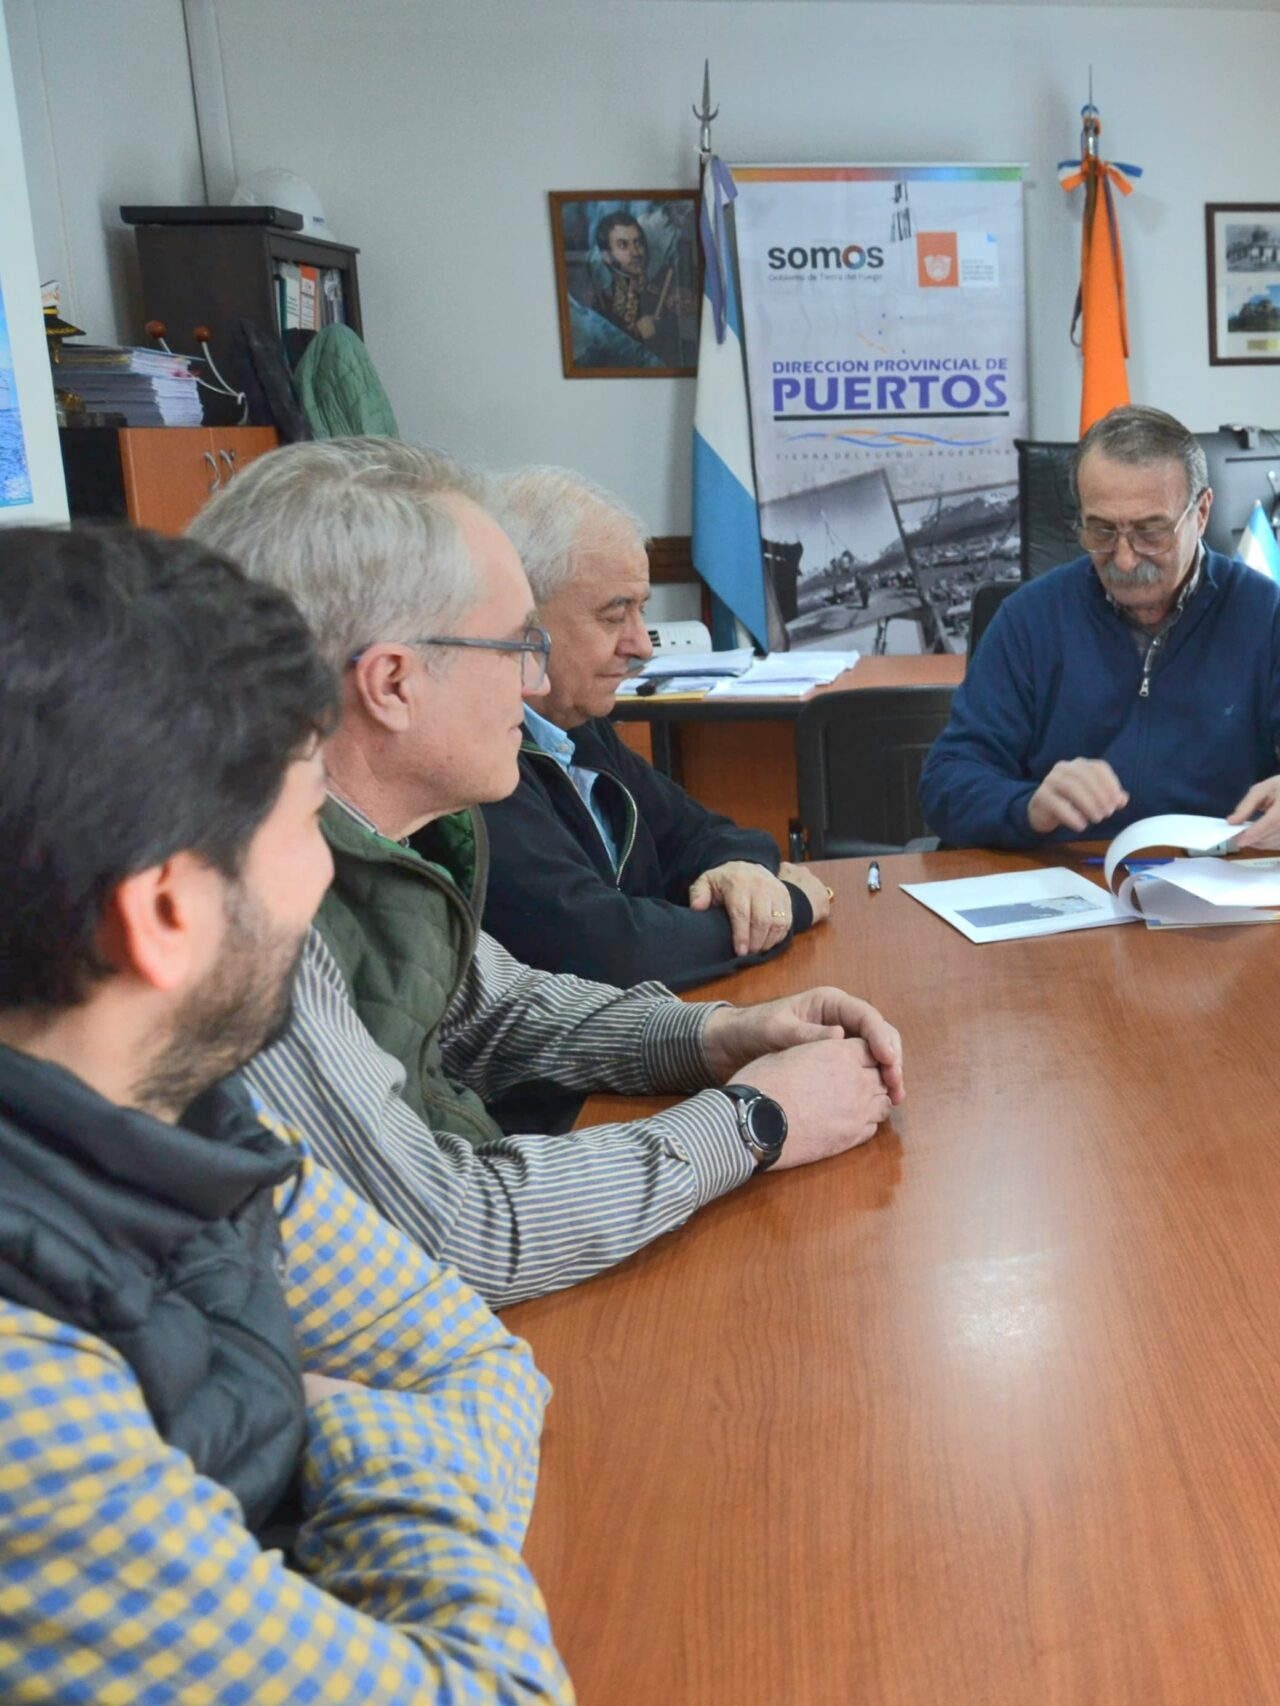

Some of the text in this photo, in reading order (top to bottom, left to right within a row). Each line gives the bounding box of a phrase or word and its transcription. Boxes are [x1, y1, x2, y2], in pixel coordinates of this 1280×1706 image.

[768, 245, 884, 270] somos
[772, 358, 1008, 374] DIRECCION PROVINCIAL DE
[772, 374, 1008, 412] PUERTOS
